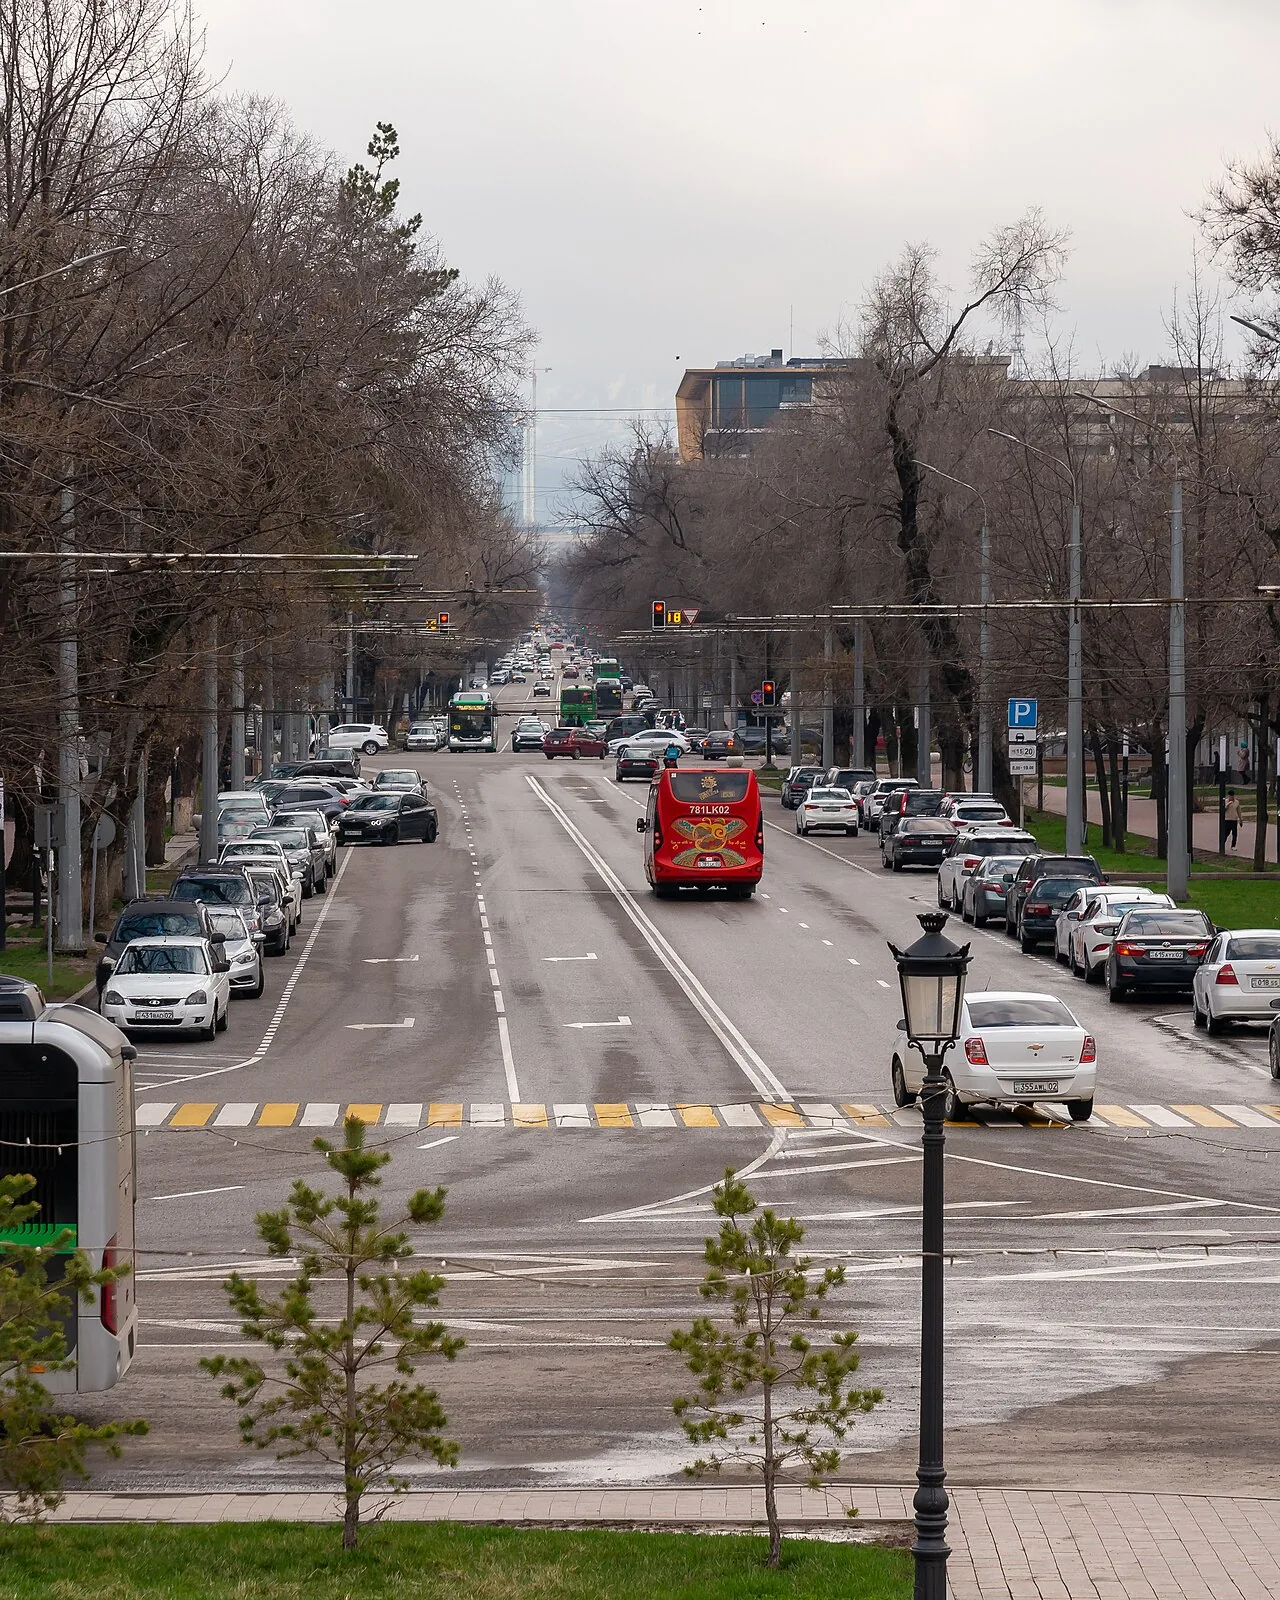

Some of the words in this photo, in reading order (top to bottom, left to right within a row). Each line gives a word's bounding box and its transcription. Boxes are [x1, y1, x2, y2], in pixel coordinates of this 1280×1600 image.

[667, 612, 681, 623] 18
[1014, 702, 1031, 724] P
[689, 805, 730, 814] 781LK02
